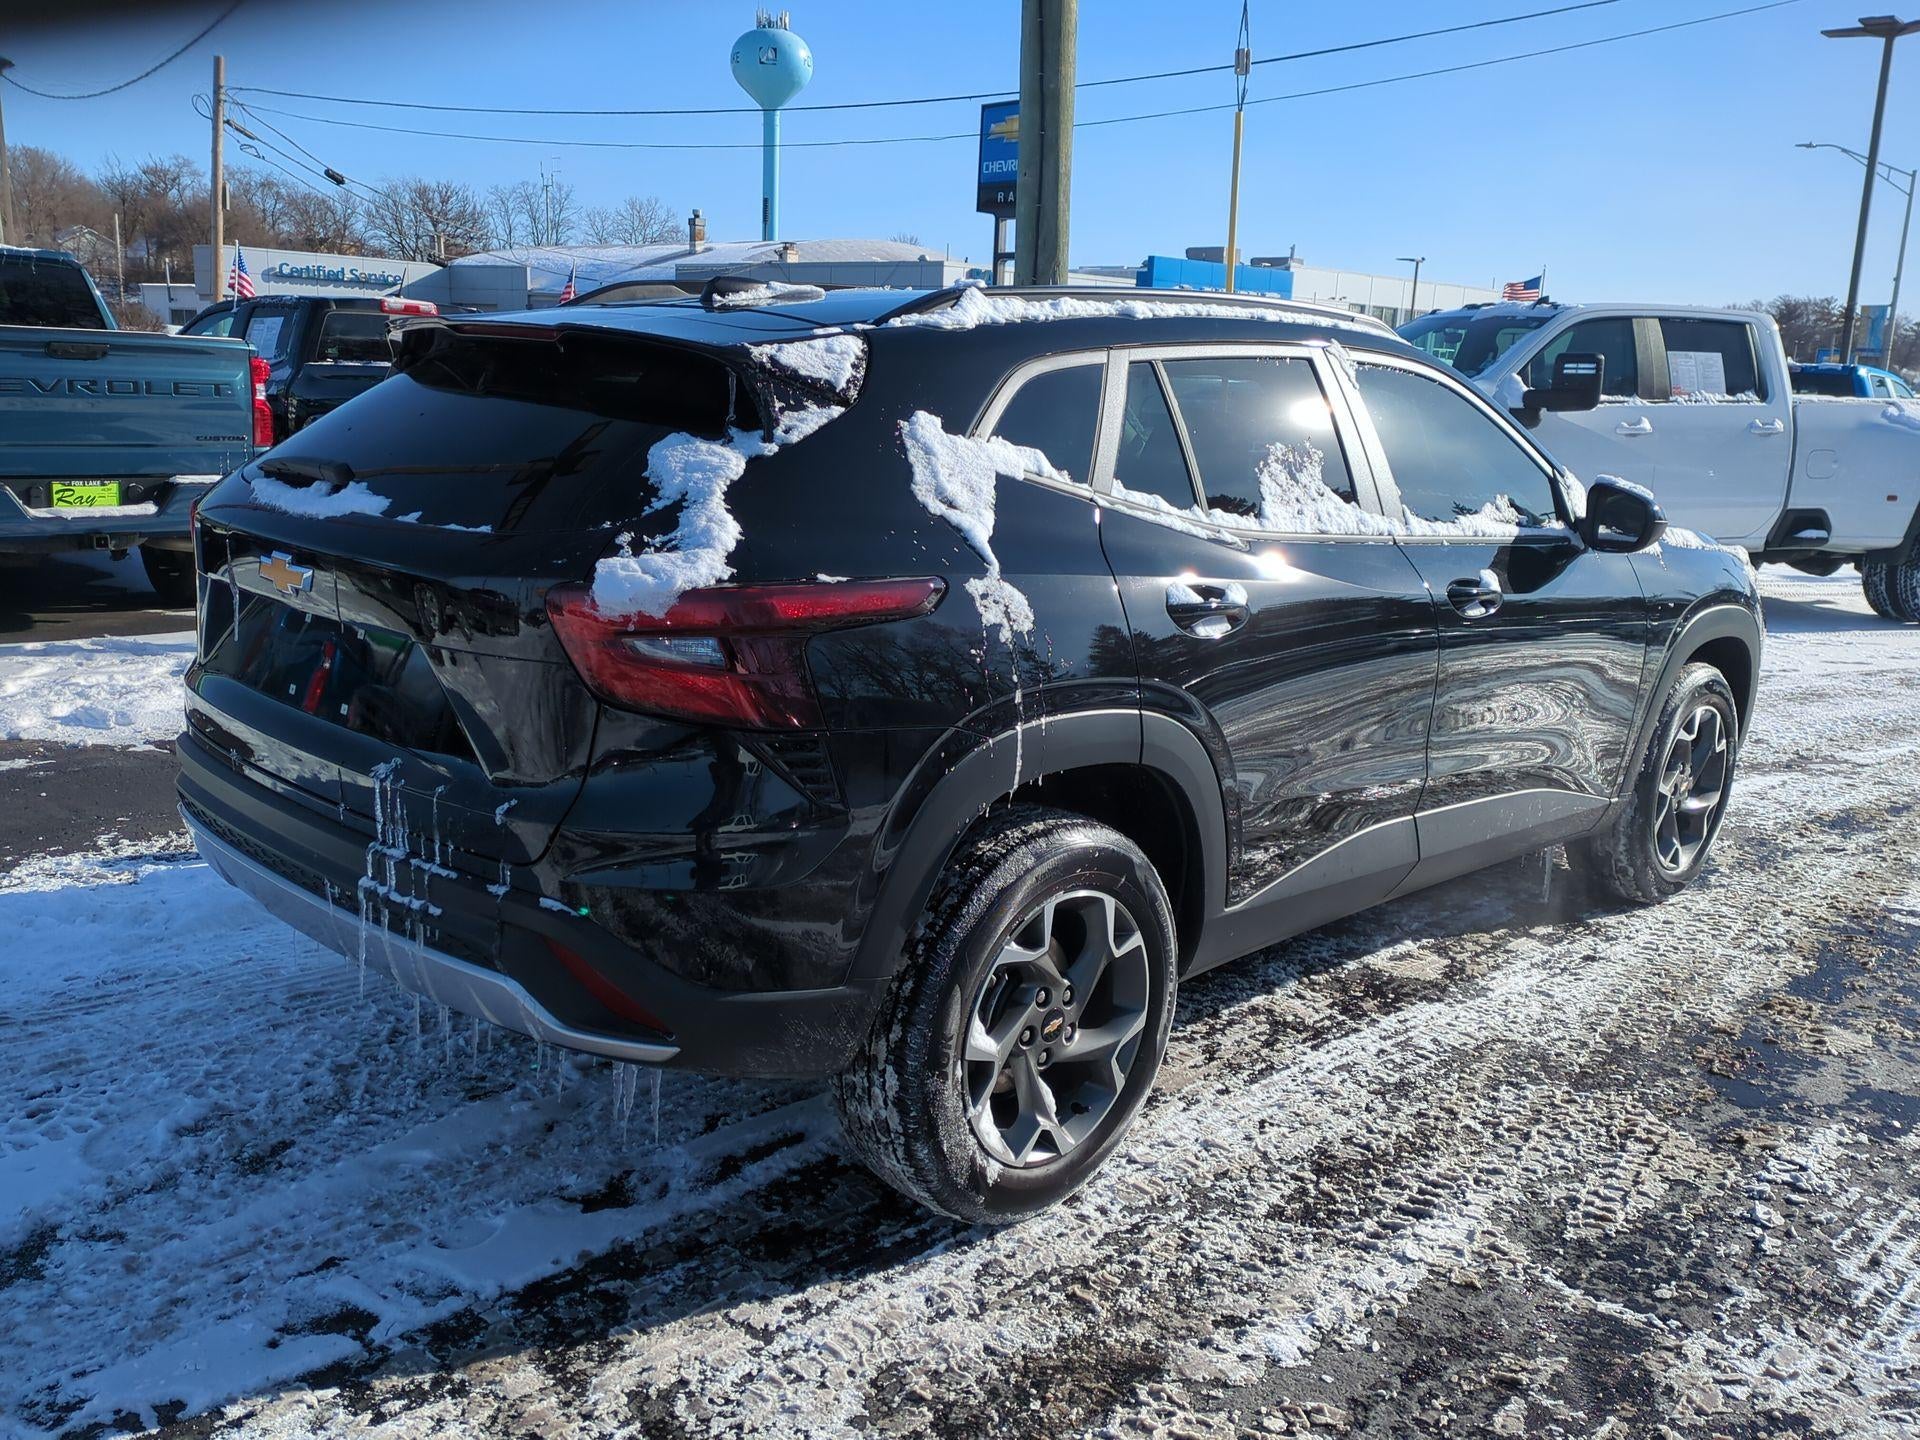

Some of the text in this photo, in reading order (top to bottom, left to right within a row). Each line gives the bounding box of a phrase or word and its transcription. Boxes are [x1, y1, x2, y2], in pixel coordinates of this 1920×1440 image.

[278, 262, 401, 285] Certified Service
[195, 434, 247, 442] CUSTOM
[54, 488, 98, 508] Ray
